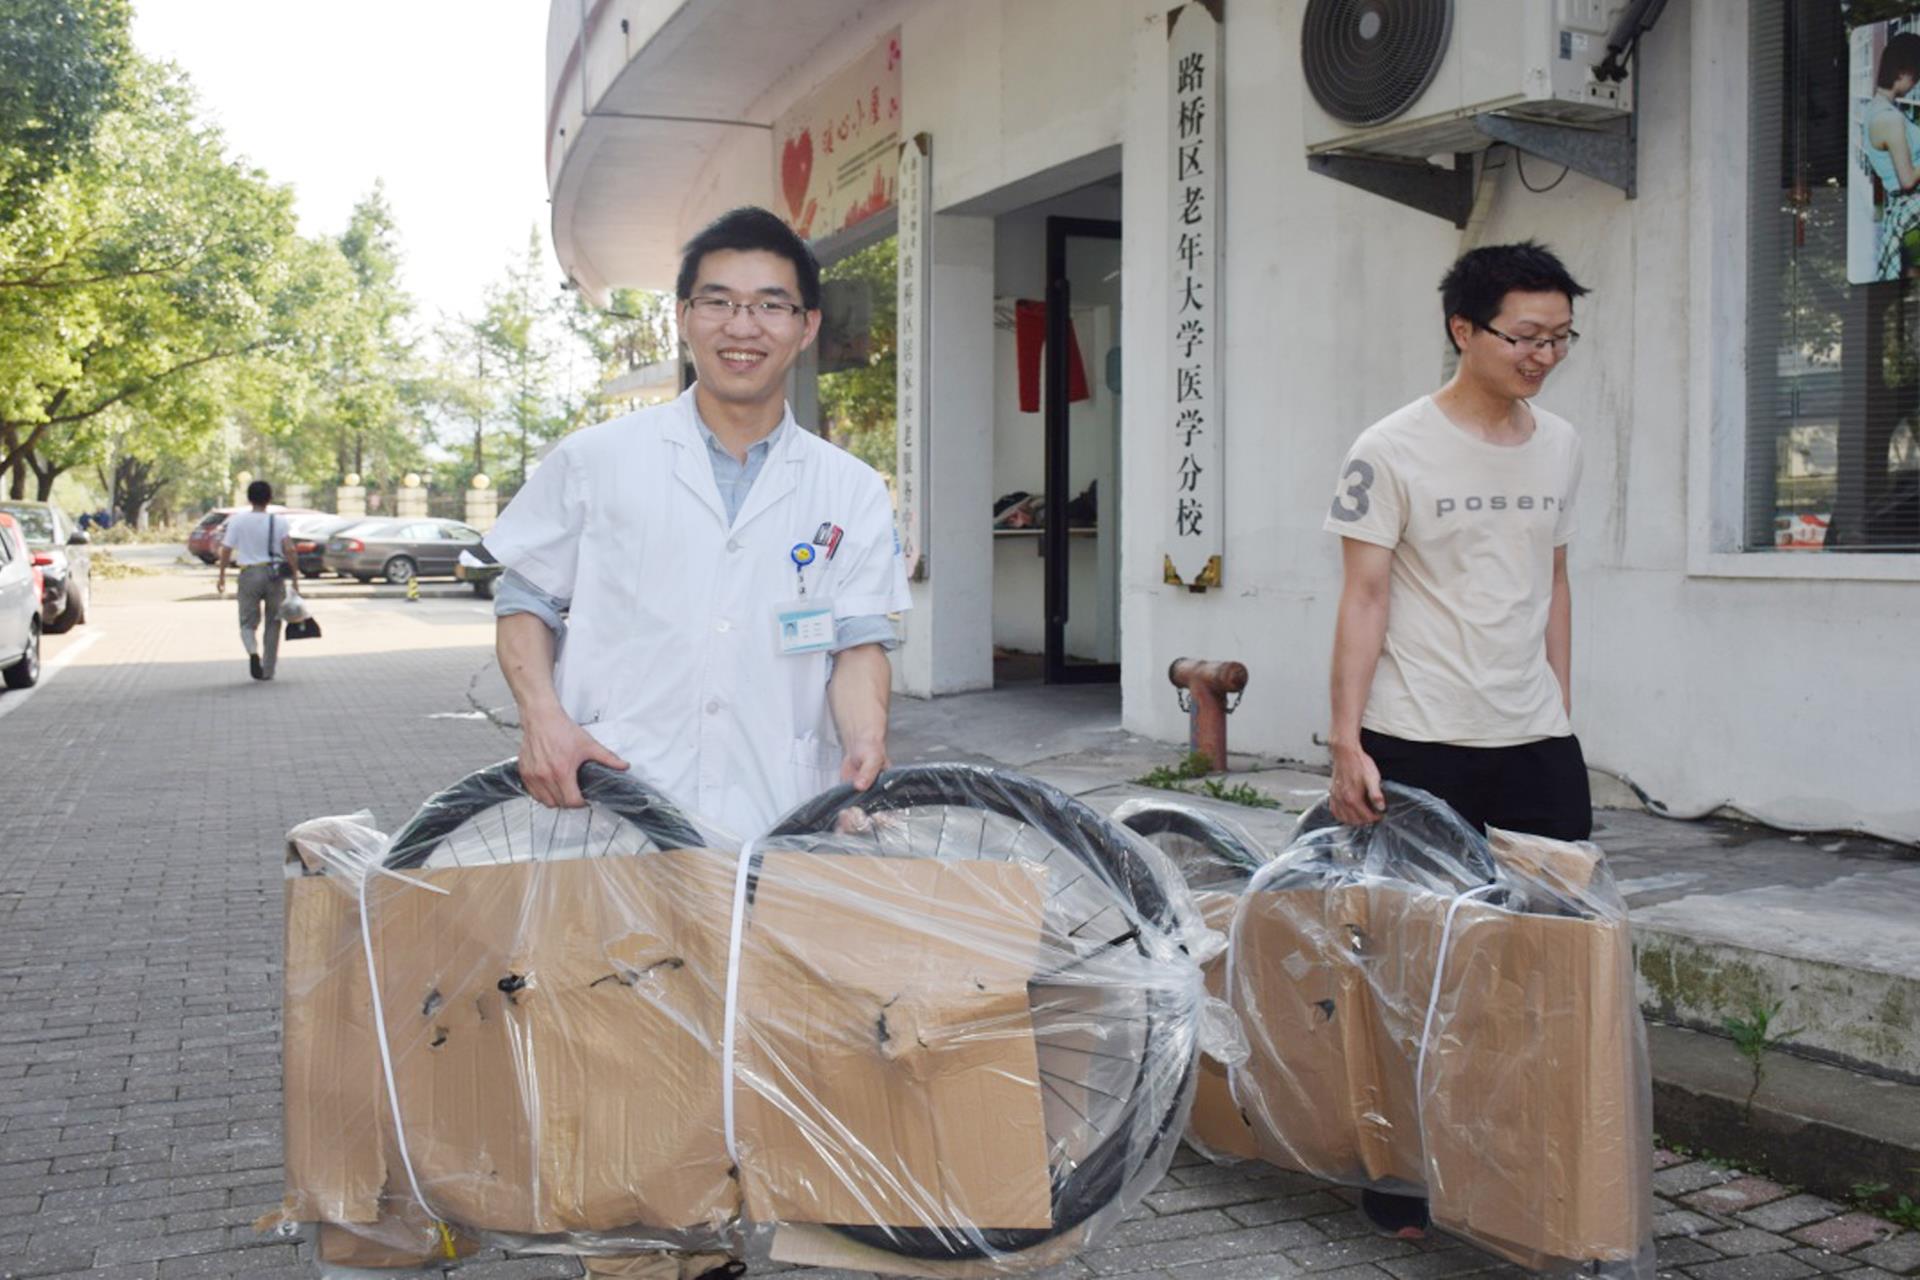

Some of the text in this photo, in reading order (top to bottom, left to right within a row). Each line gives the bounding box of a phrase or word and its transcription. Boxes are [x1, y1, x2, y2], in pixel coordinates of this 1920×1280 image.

[1176, 52, 1204, 536] 路桥区老年大学医学分校
[1330, 459, 1375, 522] 3
